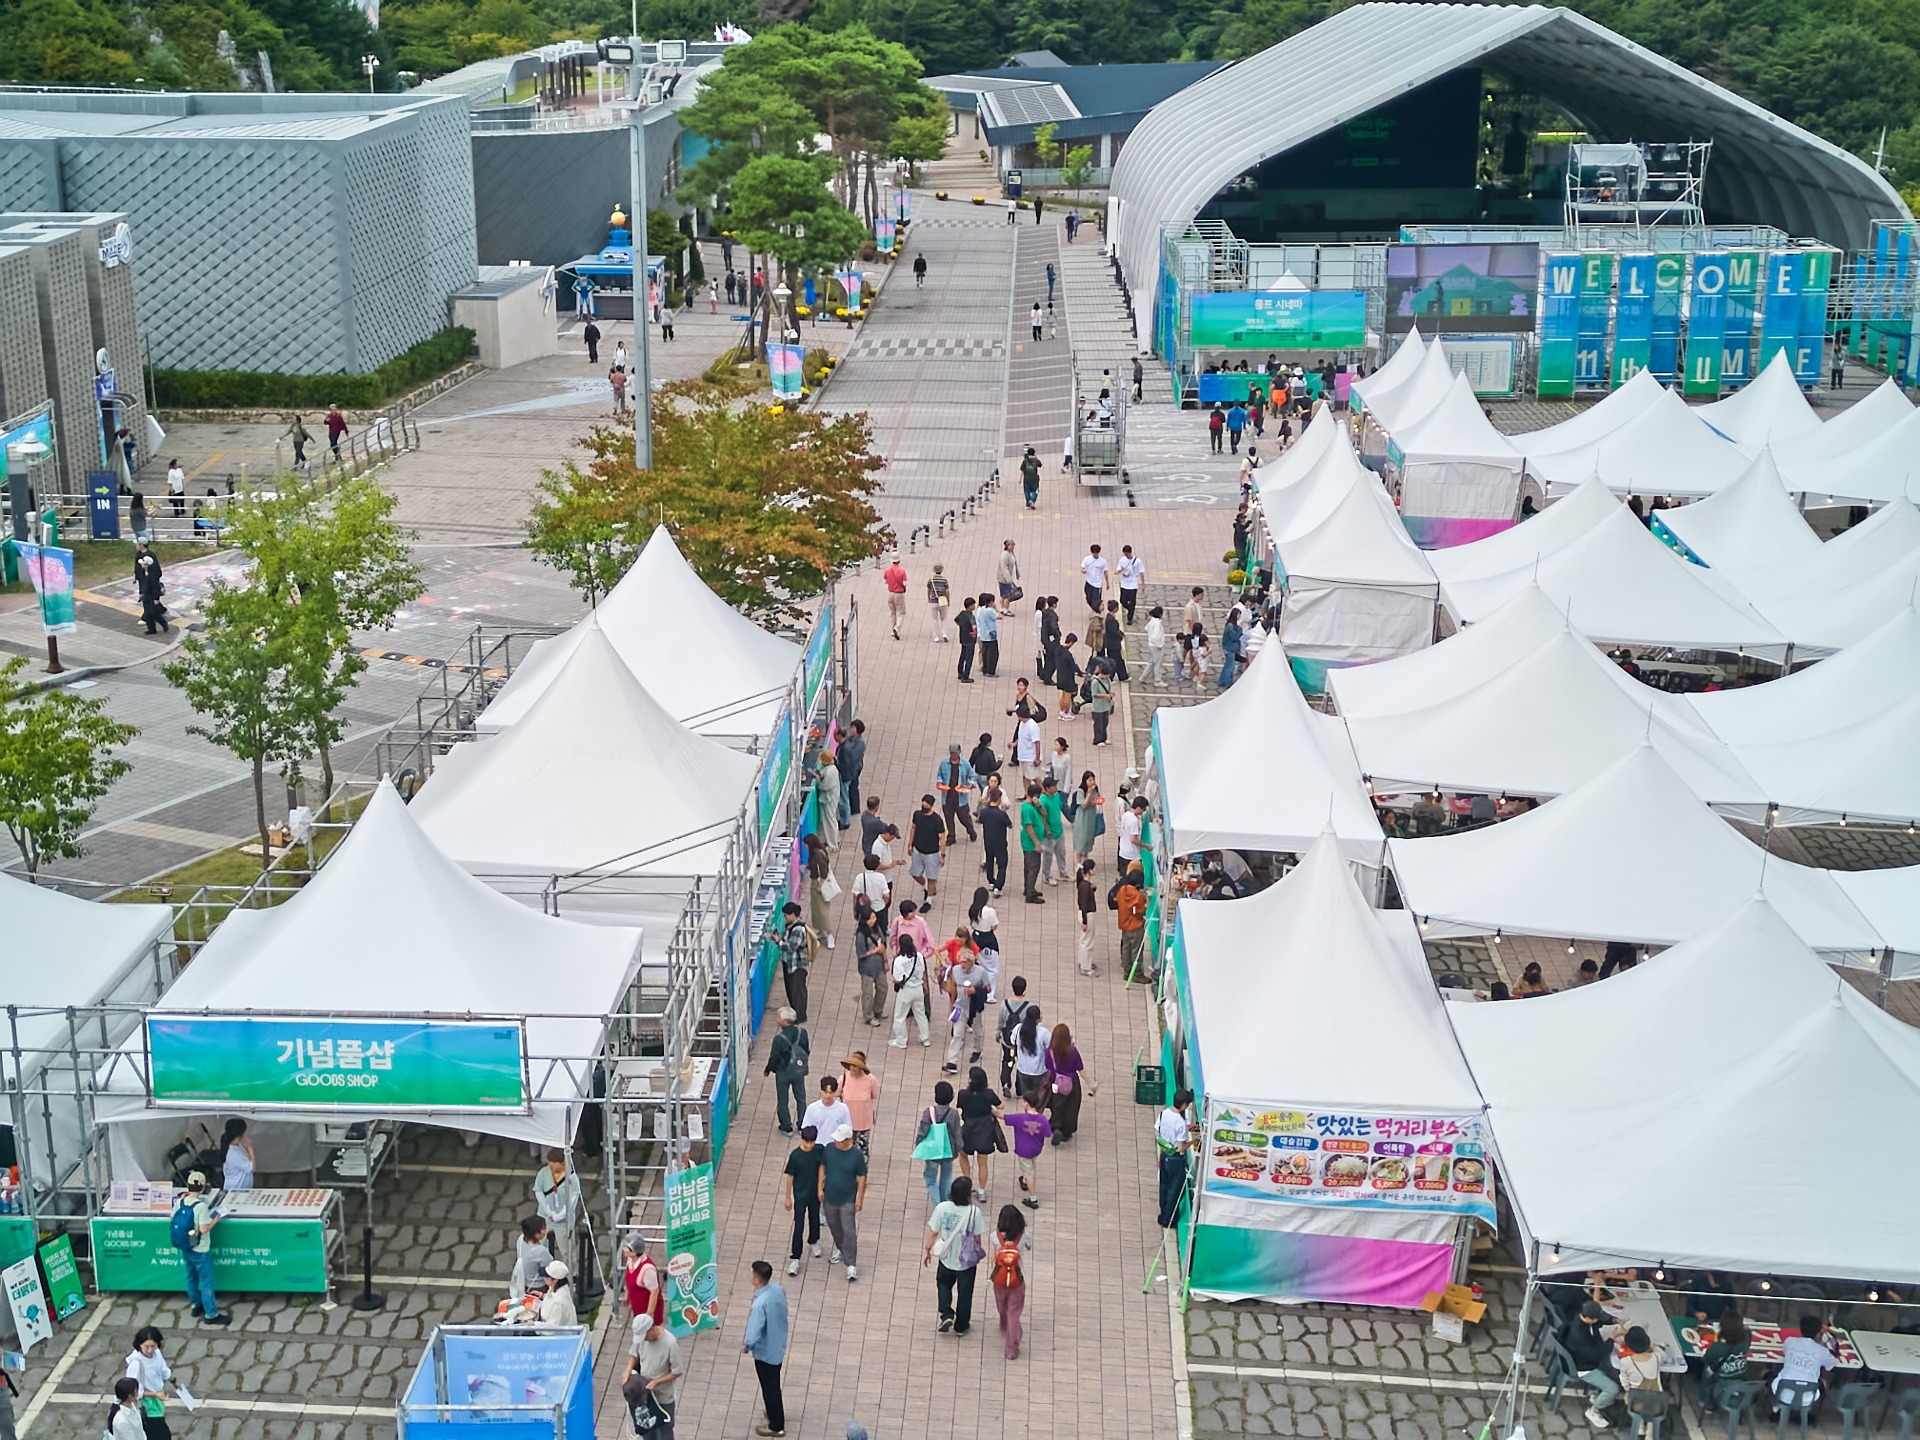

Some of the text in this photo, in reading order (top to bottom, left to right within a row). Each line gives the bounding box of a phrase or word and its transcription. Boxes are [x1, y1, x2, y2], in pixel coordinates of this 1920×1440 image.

[1552, 257, 1817, 294] WELCOME!
[1696, 348, 1812, 384] UMF
[96, 499, 111, 510] IN
[276, 1037, 396, 1071] 기념품샵
[295, 1073, 379, 1088] GOODS SHOP
[1316, 1115, 1371, 1136] 맛있는
[1375, 1117, 1427, 1138] 먹거리
[1429, 1119, 1460, 1139] 부스
[668, 1175, 709, 1201] 반납은
[669, 1194, 710, 1217] 여기로
[670, 1210, 711, 1230] 해주세요
[150, 1258, 157, 1266] A
[159, 1258, 178, 1267] Way
